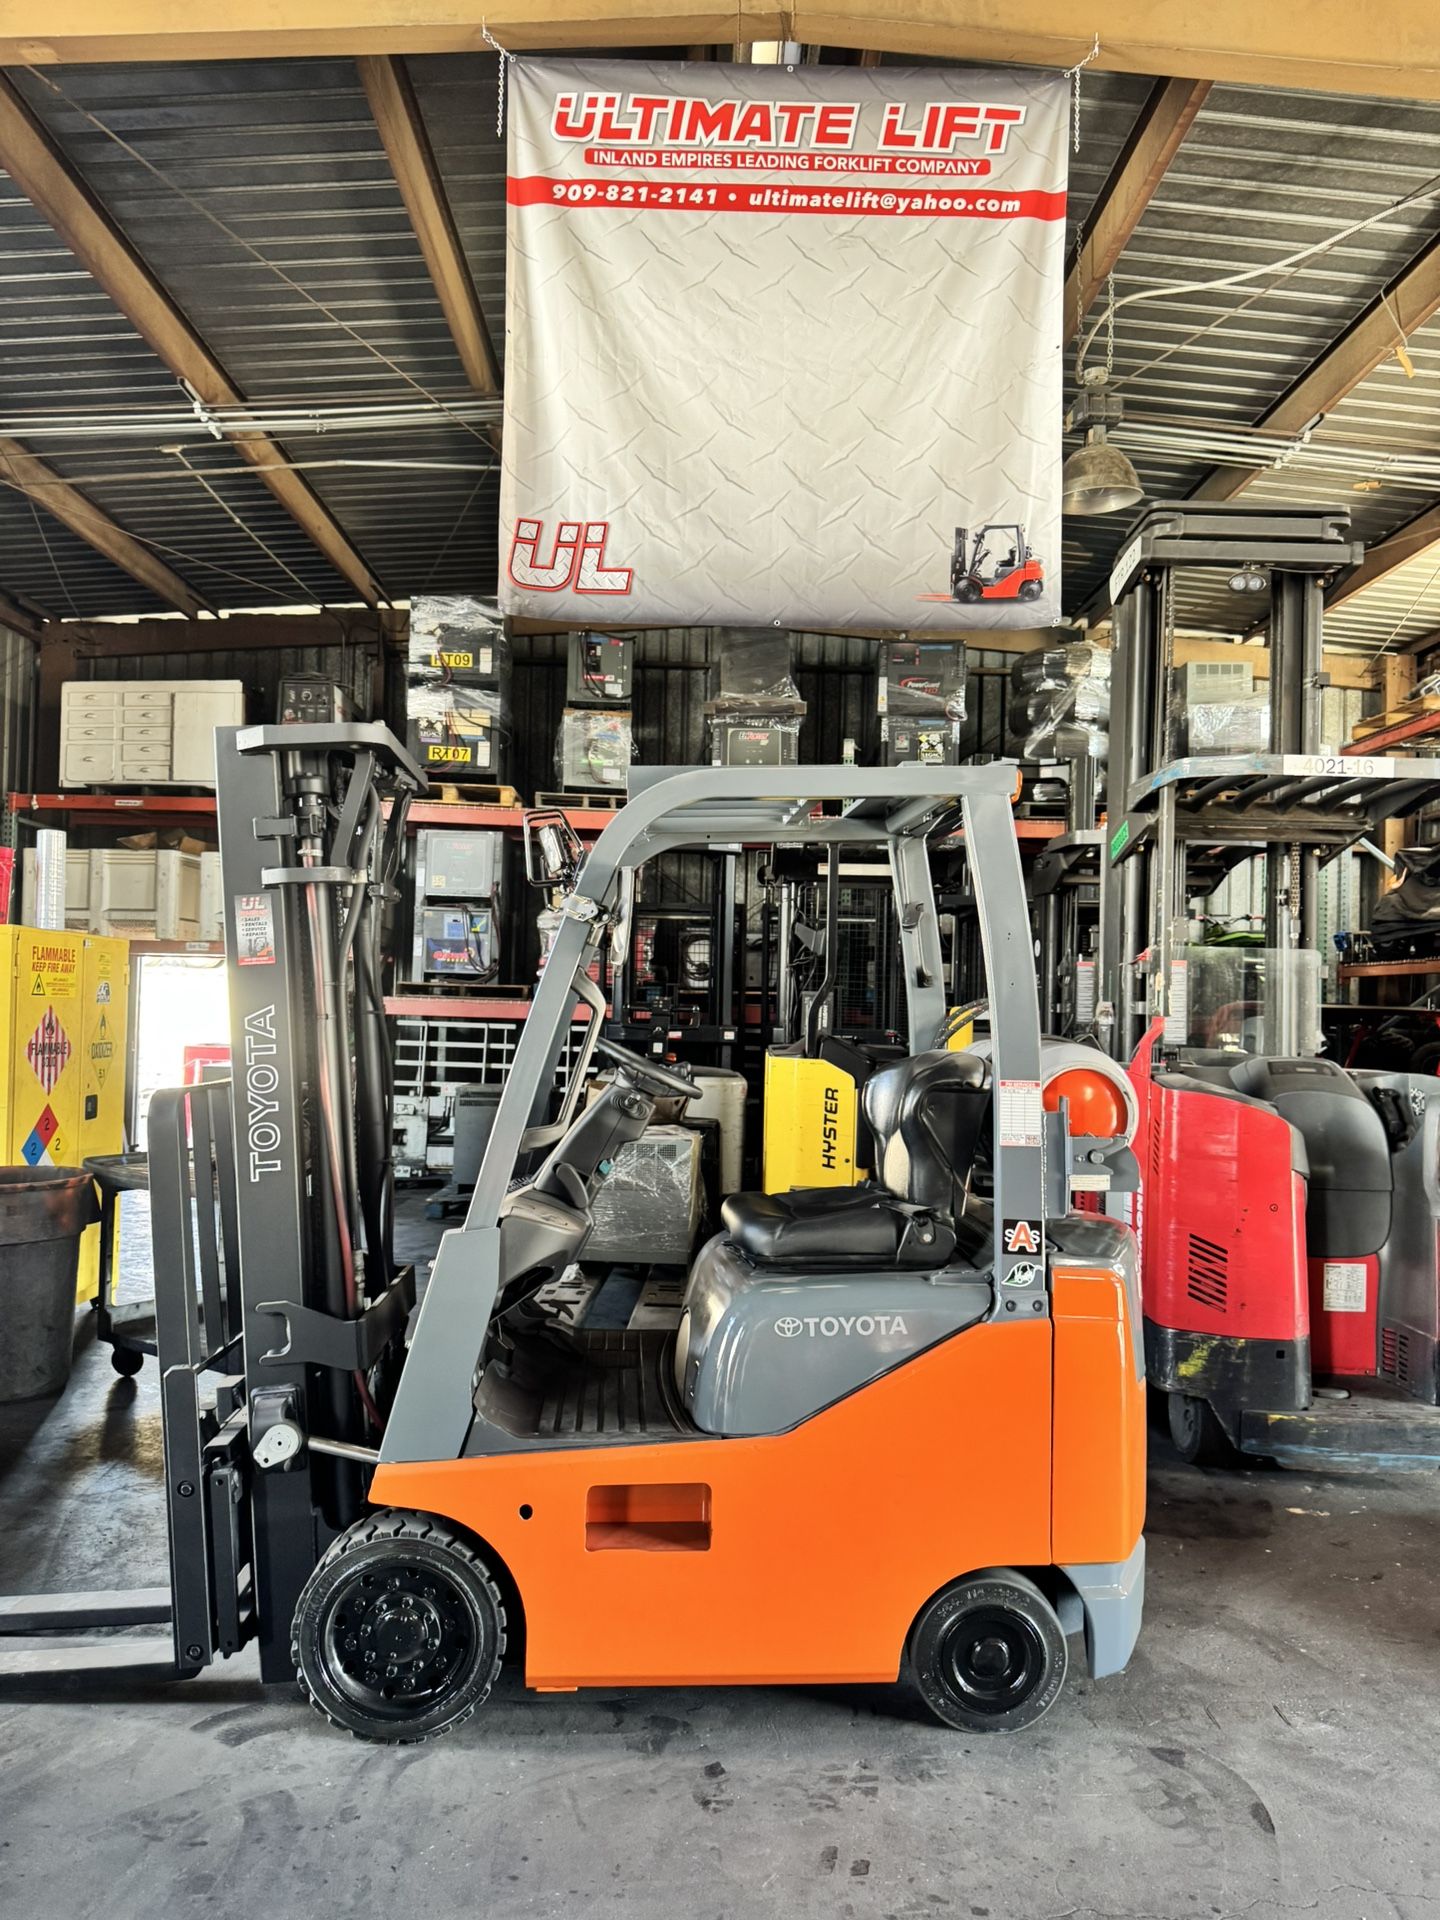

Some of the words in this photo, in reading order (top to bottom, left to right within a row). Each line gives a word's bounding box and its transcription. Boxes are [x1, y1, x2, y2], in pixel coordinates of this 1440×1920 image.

[551, 92, 861, 149] ULTIMATE
[877, 102, 1027, 154] LIFT
[593, 150, 657, 166] INLAND
[661, 153, 732, 168] EMPIRES
[736, 154, 809, 169] LEADING
[814, 157, 892, 172] FORKLIFT
[895, 157, 981, 174] COMPANY
[552, 184, 717, 204] 909-821-2141
[749, 187, 1021, 214] ultimatelift@yahoo.com
[508, 518, 633, 594] UL
[432, 747, 468, 760] RT07
[1303, 758, 1374, 775] 4021-16
[32, 946, 76, 963] FLAMMABLE
[32, 961, 46, 972] KEEP
[47, 963, 59, 973] FIRE
[60, 965, 76, 973] AWAY
[31, 1041, 67, 1056] FLAMMABLE
[245, 1004, 282, 1183] TOYOTA
[44, 1118, 50, 1131] 2
[822, 1087, 839, 1170] HYSTER
[30, 1142, 38, 1156] 2
[54, 1138, 61, 1151] 2
[1004, 1221, 1040, 1253] SAS
[803, 1316, 909, 1337] TOYOTA
